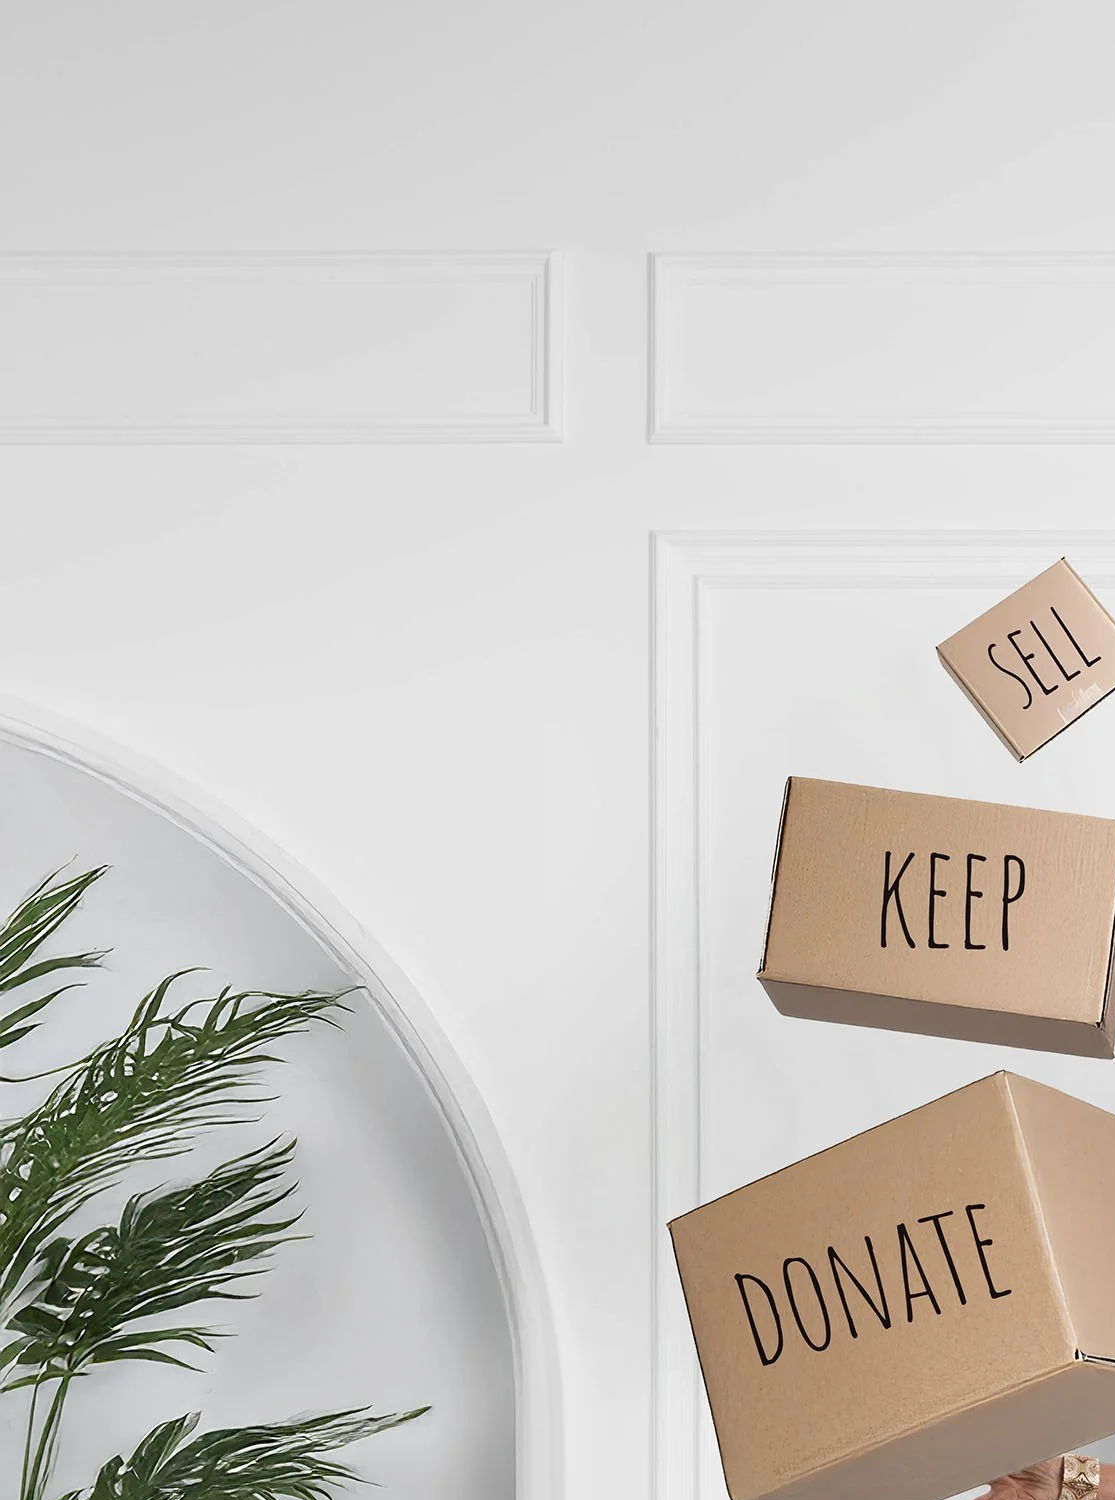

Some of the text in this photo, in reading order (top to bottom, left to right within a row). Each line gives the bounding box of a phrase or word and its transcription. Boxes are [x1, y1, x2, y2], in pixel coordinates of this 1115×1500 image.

[988, 607, 1101, 709] SELL
[881, 851, 1025, 951] KEEP
[734, 1204, 1012, 1366] DONATE
